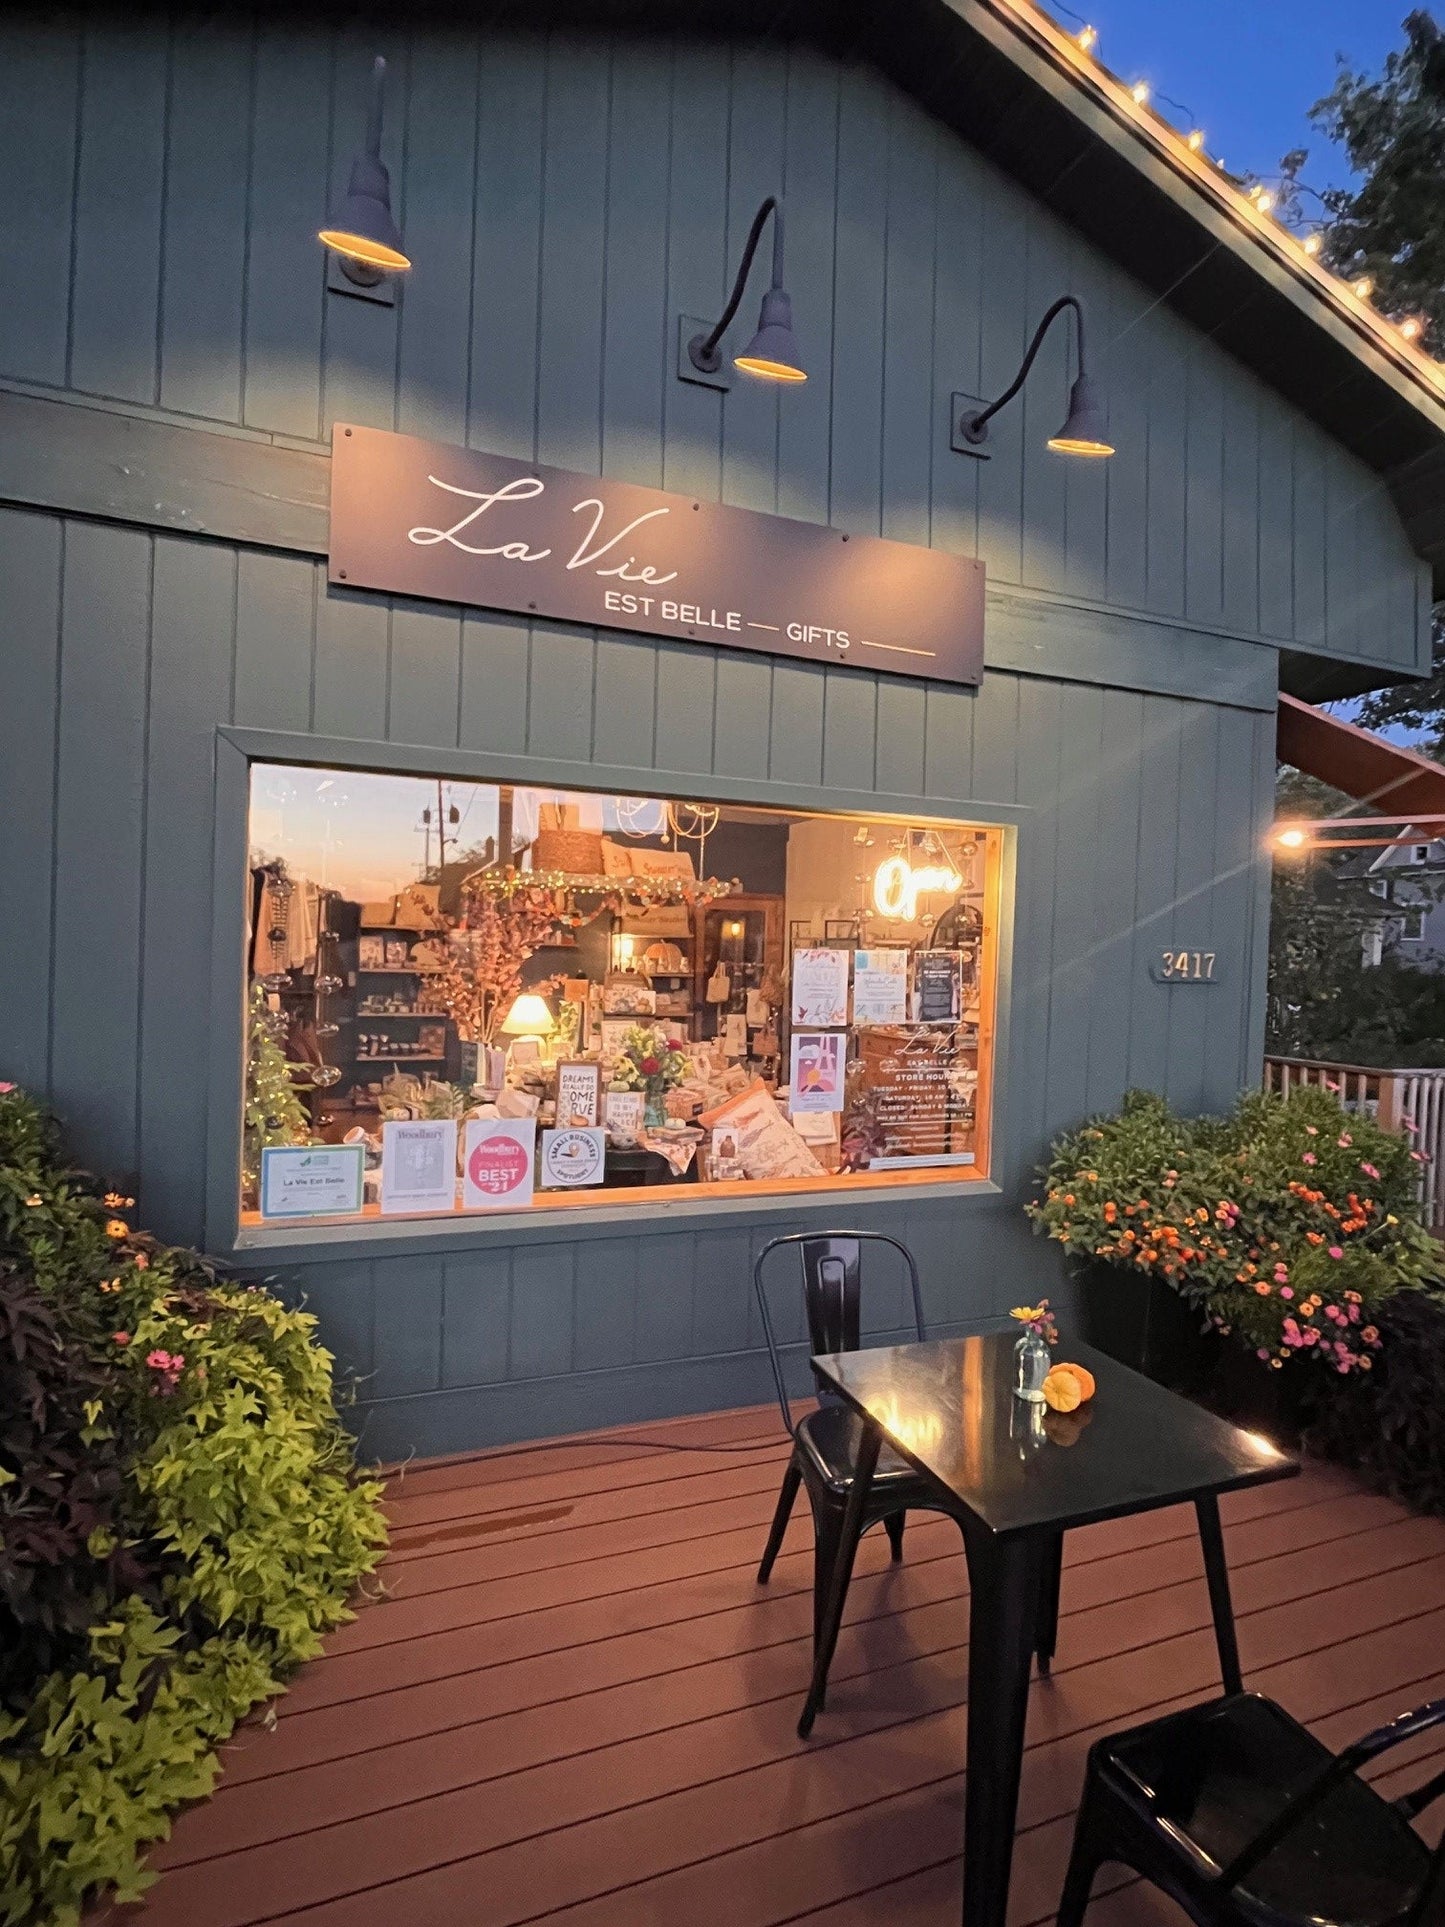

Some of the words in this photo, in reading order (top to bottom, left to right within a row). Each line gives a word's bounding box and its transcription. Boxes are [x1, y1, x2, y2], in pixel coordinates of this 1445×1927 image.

[408, 475, 552, 561] La
[566, 498, 678, 585] Vie
[604, 590, 655, 616] EST
[661, 600, 742, 631] BELLE
[786, 622, 850, 649] GIFTS
[1162, 952, 1216, 978] 3417
[894, 1029, 929, 1055] La
[930, 1028, 961, 1055] Vie
[562, 1074, 594, 1083] DREAMS
[895, 1073, 924, 1082] STORE
[562, 1083, 584, 1091] REALLY
[569, 1091, 595, 1102] OME
[571, 1103, 595, 1115] RUE
[551, 1136, 569, 1160] SMALL
[569, 1134, 596, 1158] BUSINESS
[479, 1168, 520, 1181] BEST
